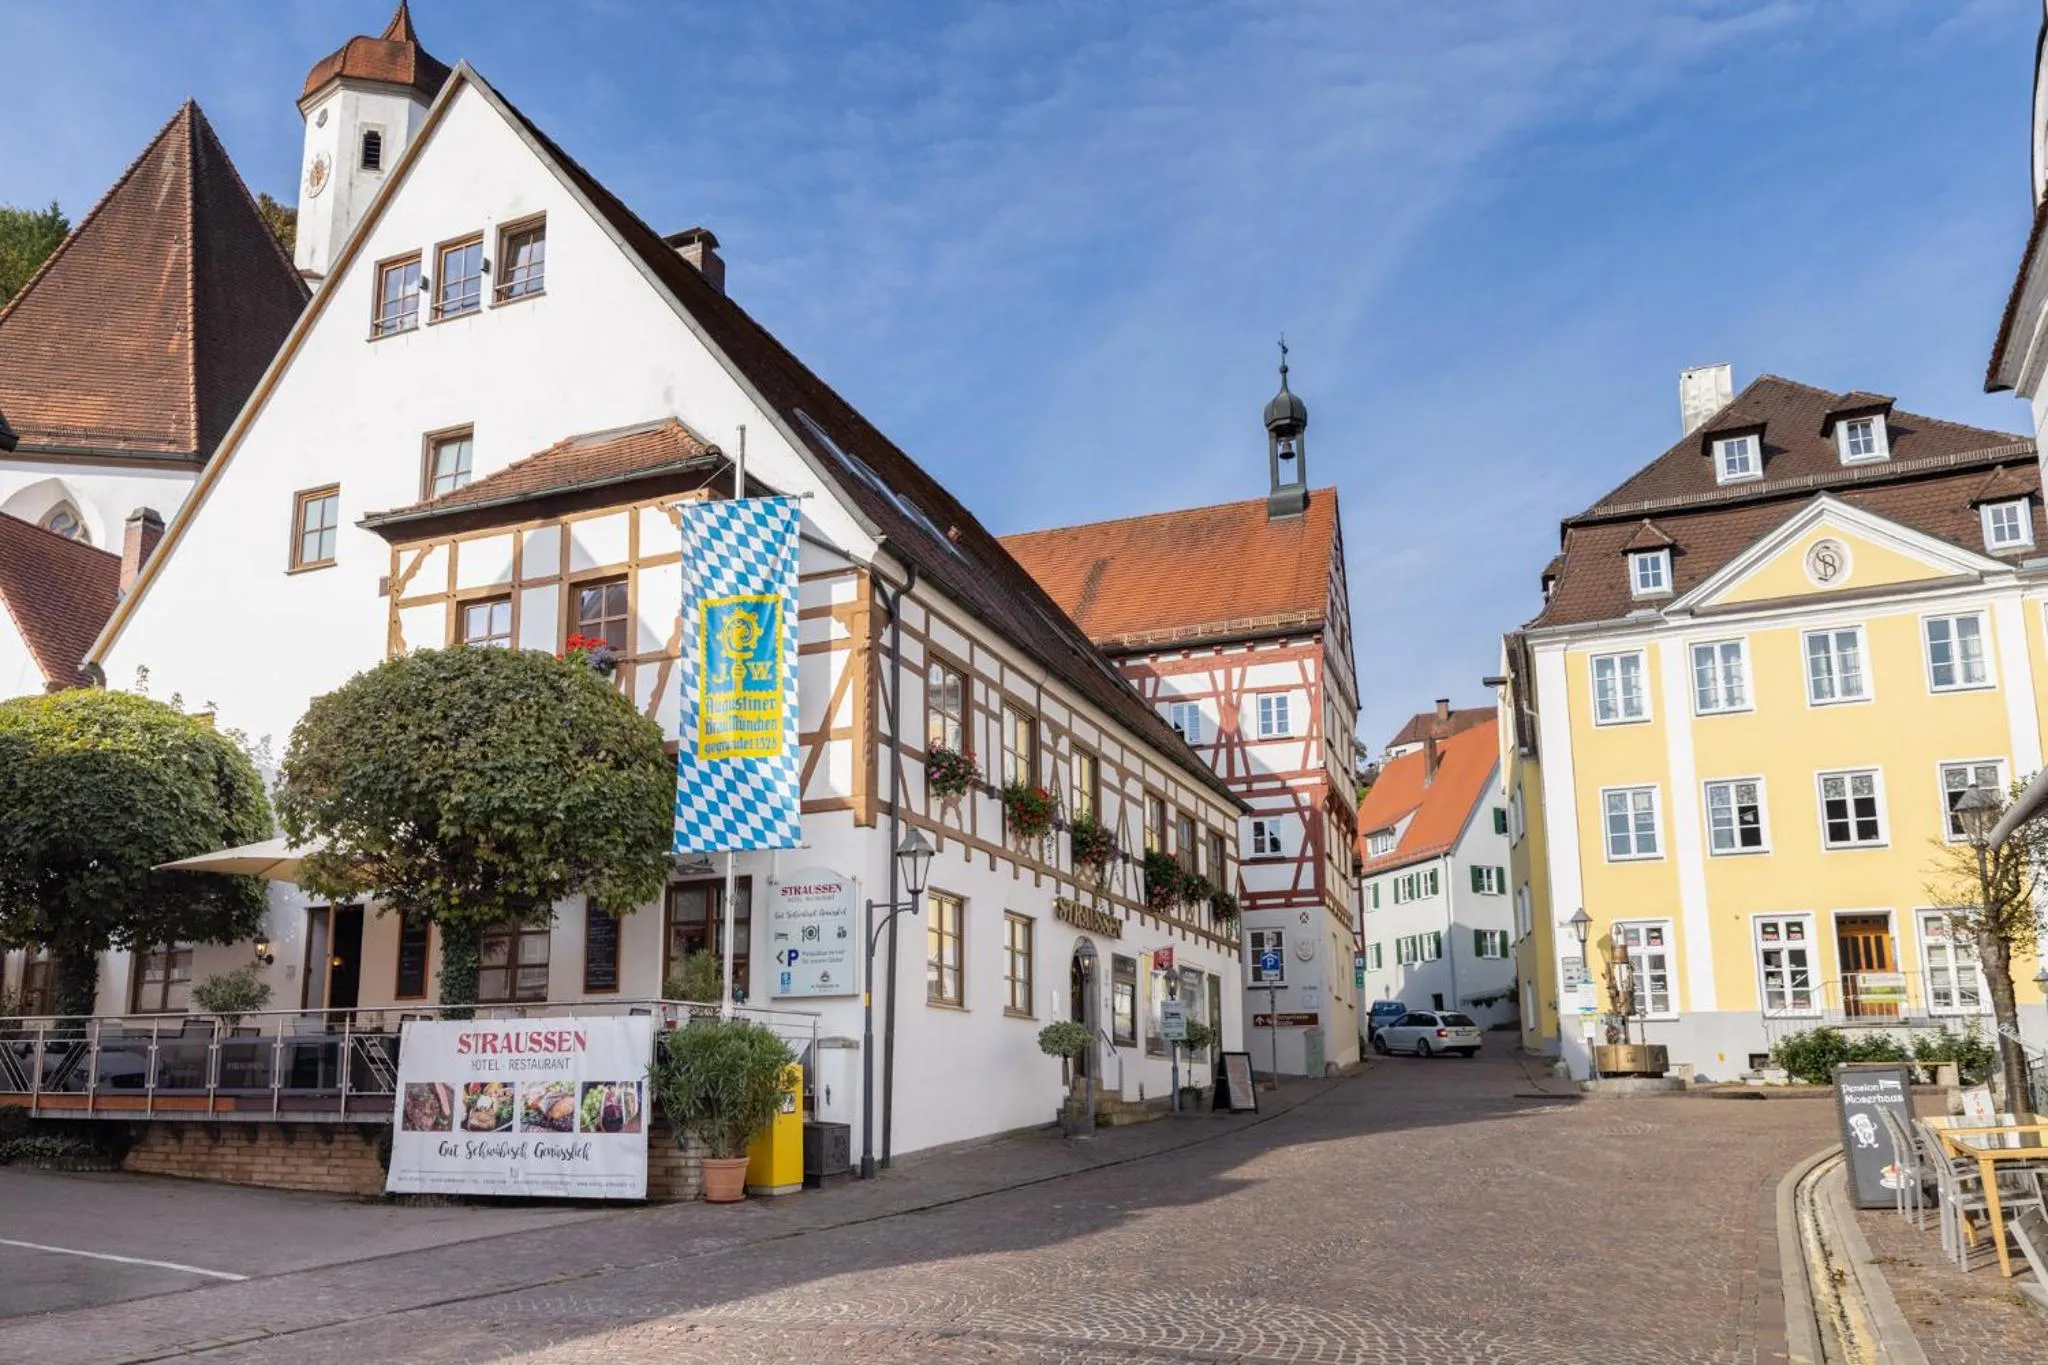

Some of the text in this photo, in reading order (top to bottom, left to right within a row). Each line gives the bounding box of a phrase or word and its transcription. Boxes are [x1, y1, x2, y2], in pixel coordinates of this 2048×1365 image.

[781, 883, 842, 897] STRAUSSEN
[1055, 896, 1122, 939] STRAUSSEN
[787, 948, 800, 967] P
[1266, 957, 1276, 969] P
[457, 1030, 587, 1054] STRAUSSEN
[471, 1057, 571, 1071] HOTEL RESTAURANT
[1841, 1083, 1880, 1094] Pension
[439, 1140, 459, 1157] Gut
